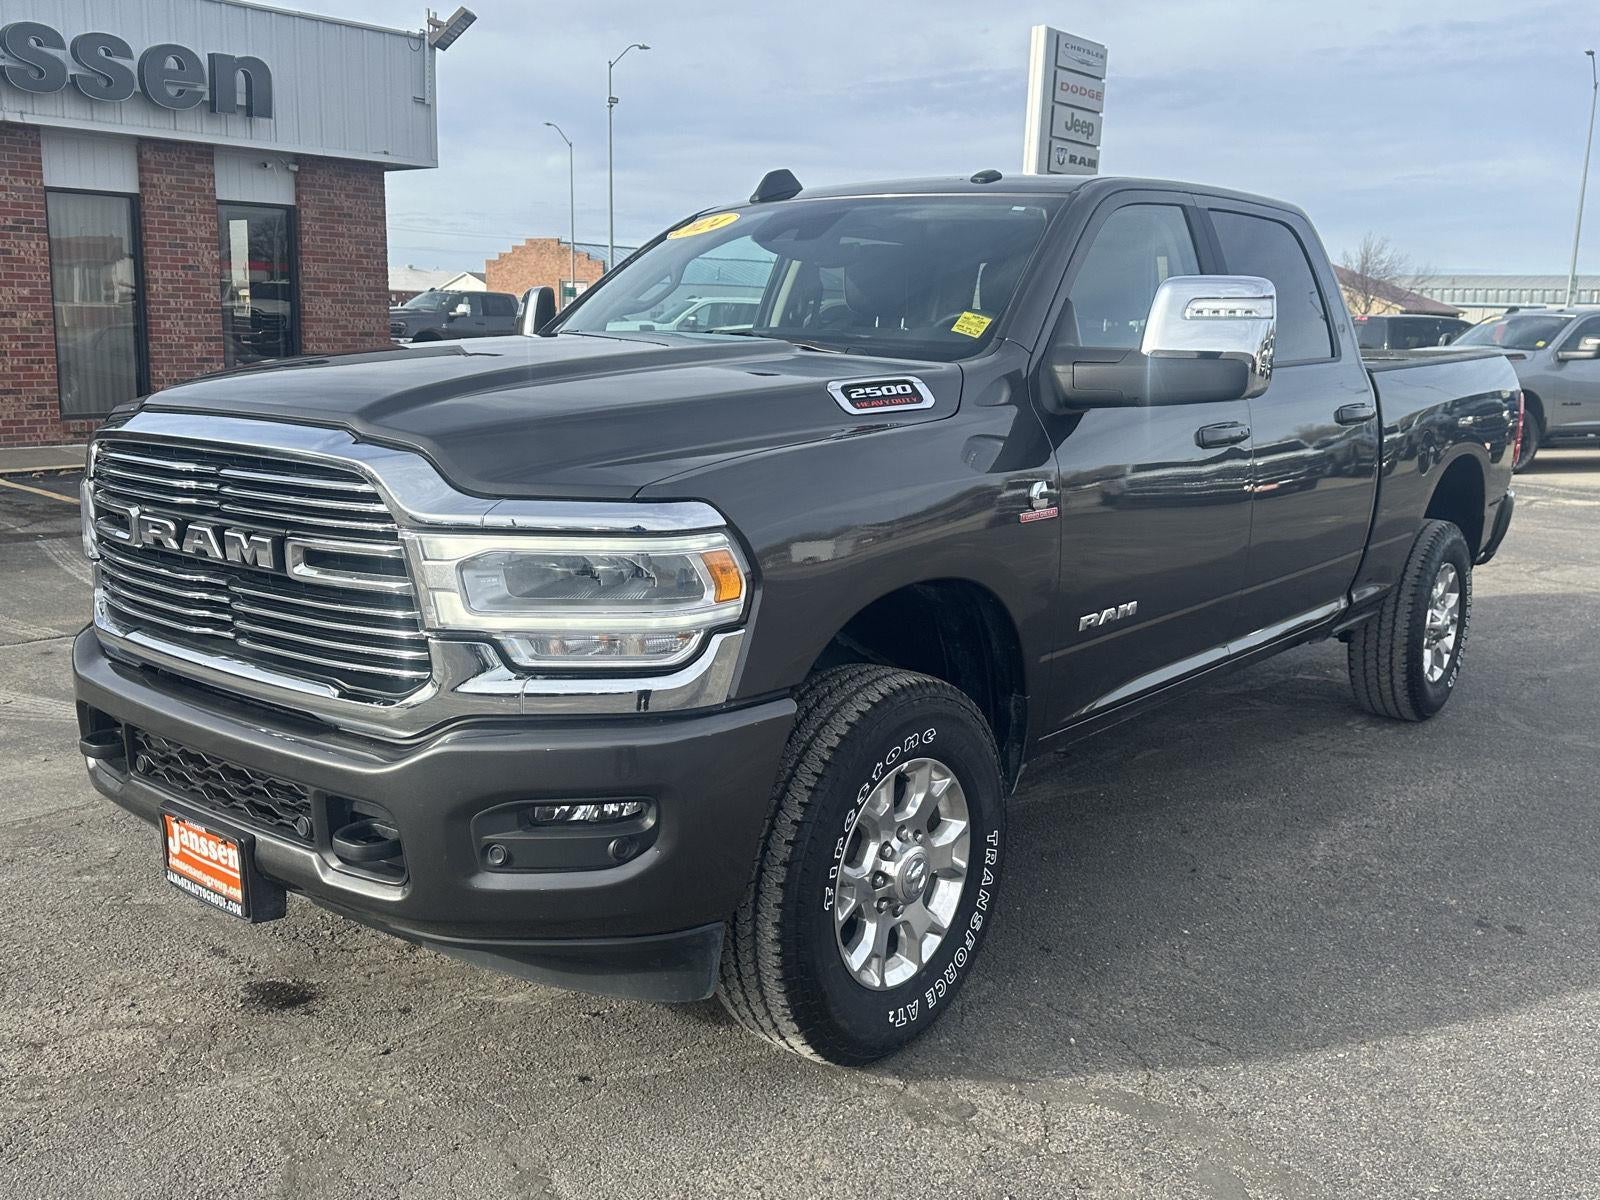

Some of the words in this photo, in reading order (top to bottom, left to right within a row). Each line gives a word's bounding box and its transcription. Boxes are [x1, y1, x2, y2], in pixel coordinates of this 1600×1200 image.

[1064, 42, 1104, 59] CHRYSLER
[1060, 81, 1103, 101] DODGE
[1065, 112, 1094, 139] Jeep
[1068, 153, 1098, 169] RAM
[848, 384, 913, 399] 2500
[856, 399, 891, 408] HEAVY
[892, 396, 918, 405] DUTY
[140, 514, 277, 570] RAM
[1078, 600, 1138, 632] RAM
[168, 821, 240, 871] Janssen
[925, 830, 999, 1009] TRANSFORCE
